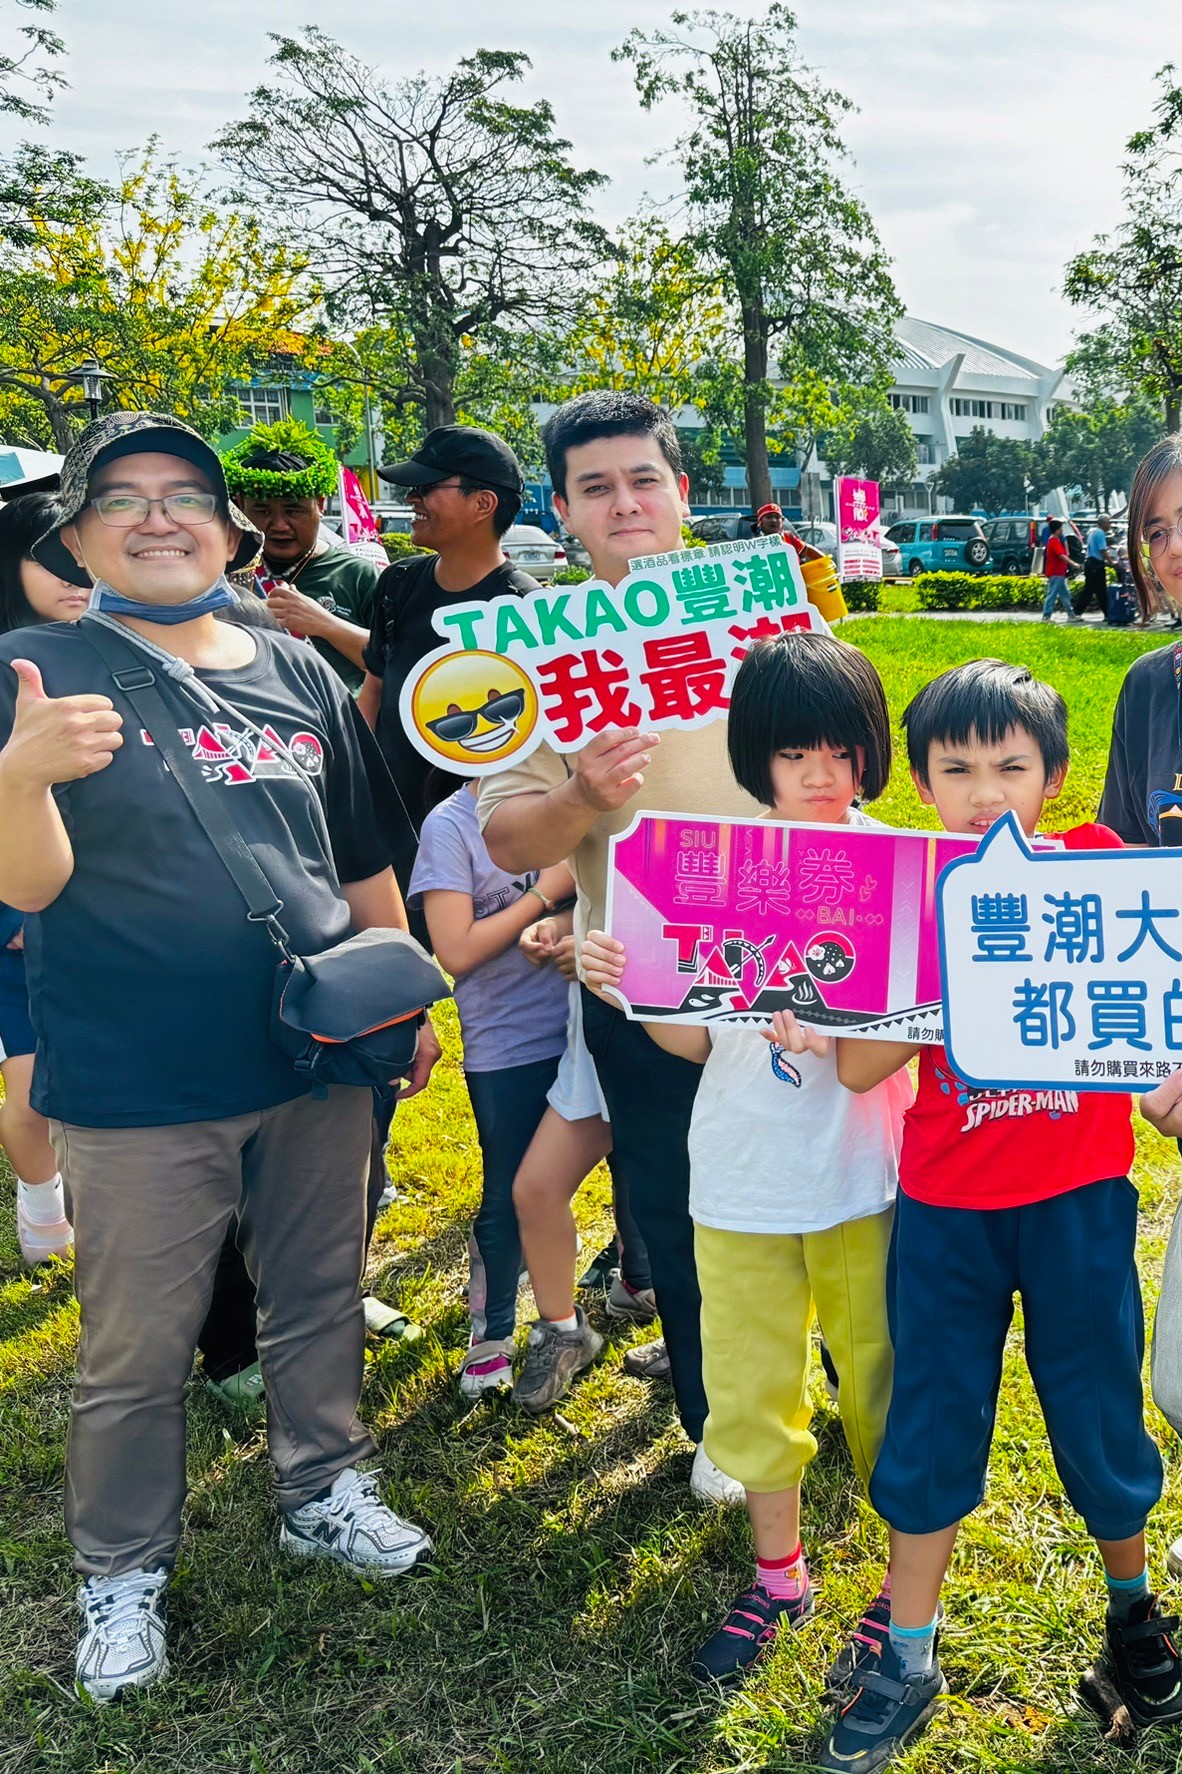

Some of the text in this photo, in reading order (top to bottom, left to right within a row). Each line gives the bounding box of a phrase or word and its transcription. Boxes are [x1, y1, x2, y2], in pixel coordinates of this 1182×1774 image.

[630, 535, 782, 571] 選酒品看標章 請認明W字樣
[536, 612, 813, 743] 我最
[680, 829, 717, 848] SIU
[672, 848, 855, 916] 豐樂券
[816, 906, 855, 926] BAI
[960, 1090, 1079, 1133] SPIDER-MAN
